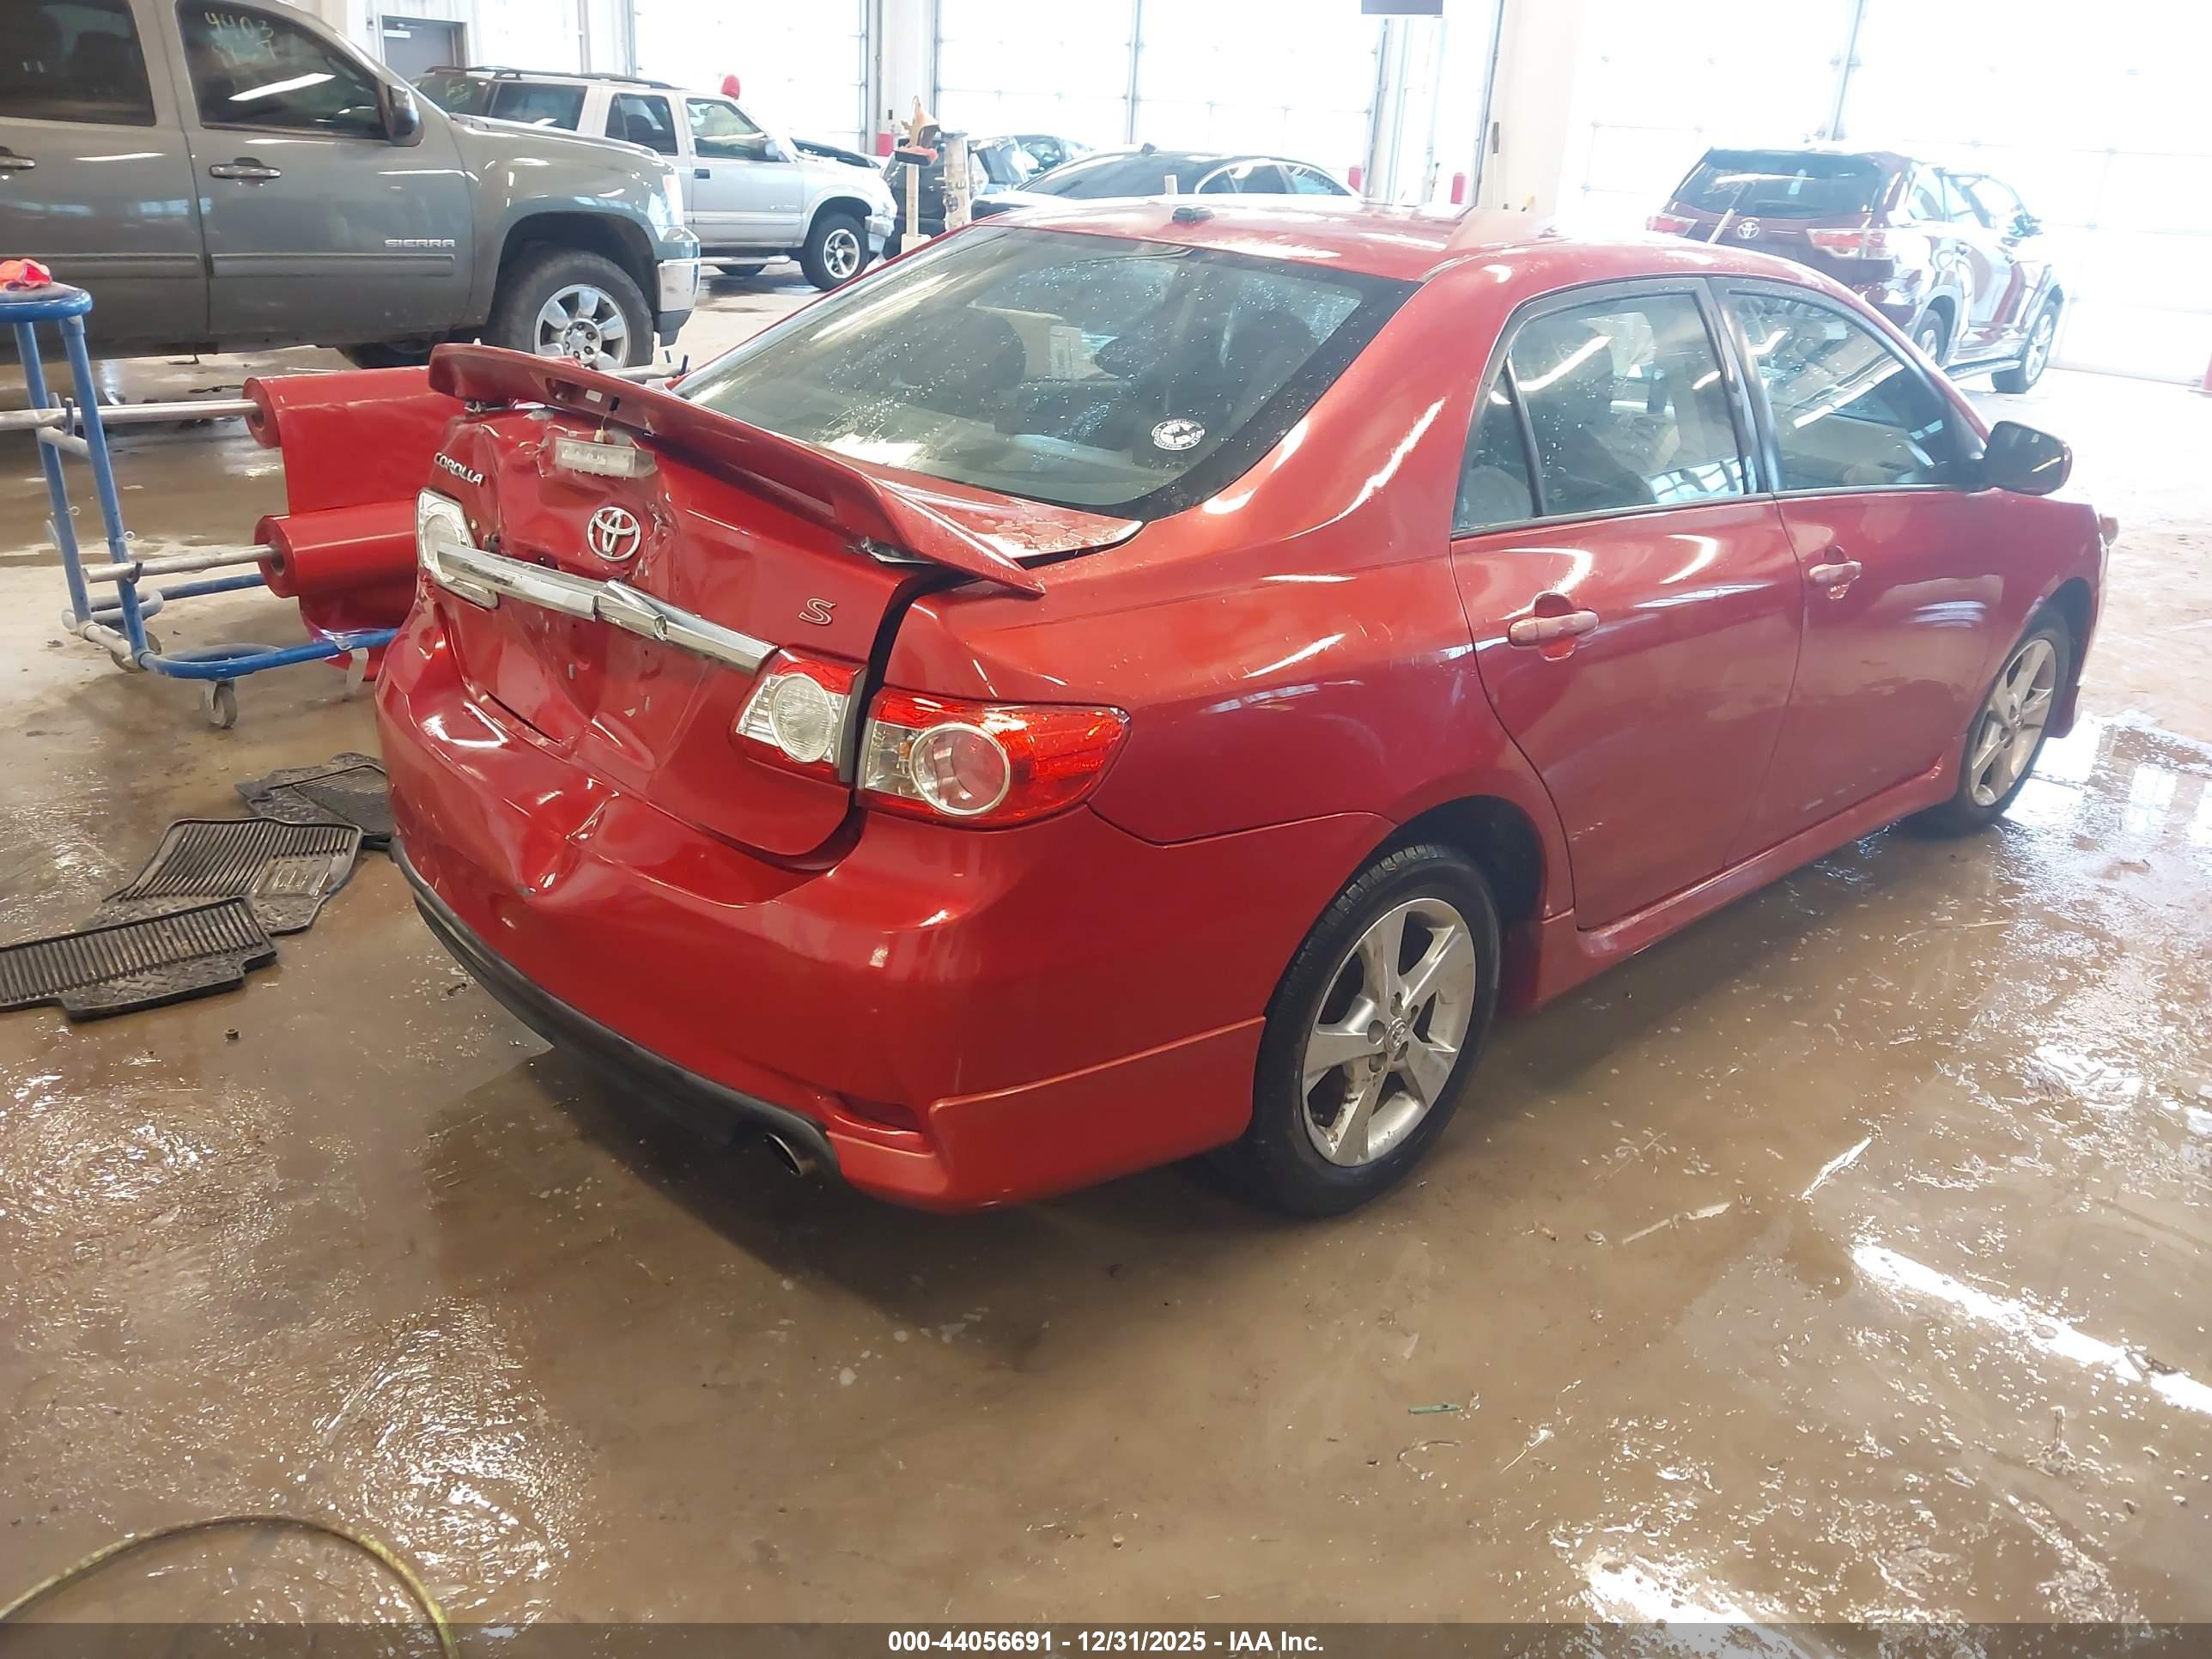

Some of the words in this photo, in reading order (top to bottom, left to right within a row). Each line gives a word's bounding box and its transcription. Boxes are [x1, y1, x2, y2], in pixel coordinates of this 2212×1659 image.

[384, 239, 455, 248] SIERRA
[433, 452, 485, 487] COROLLA
[797, 597, 836, 626] S
